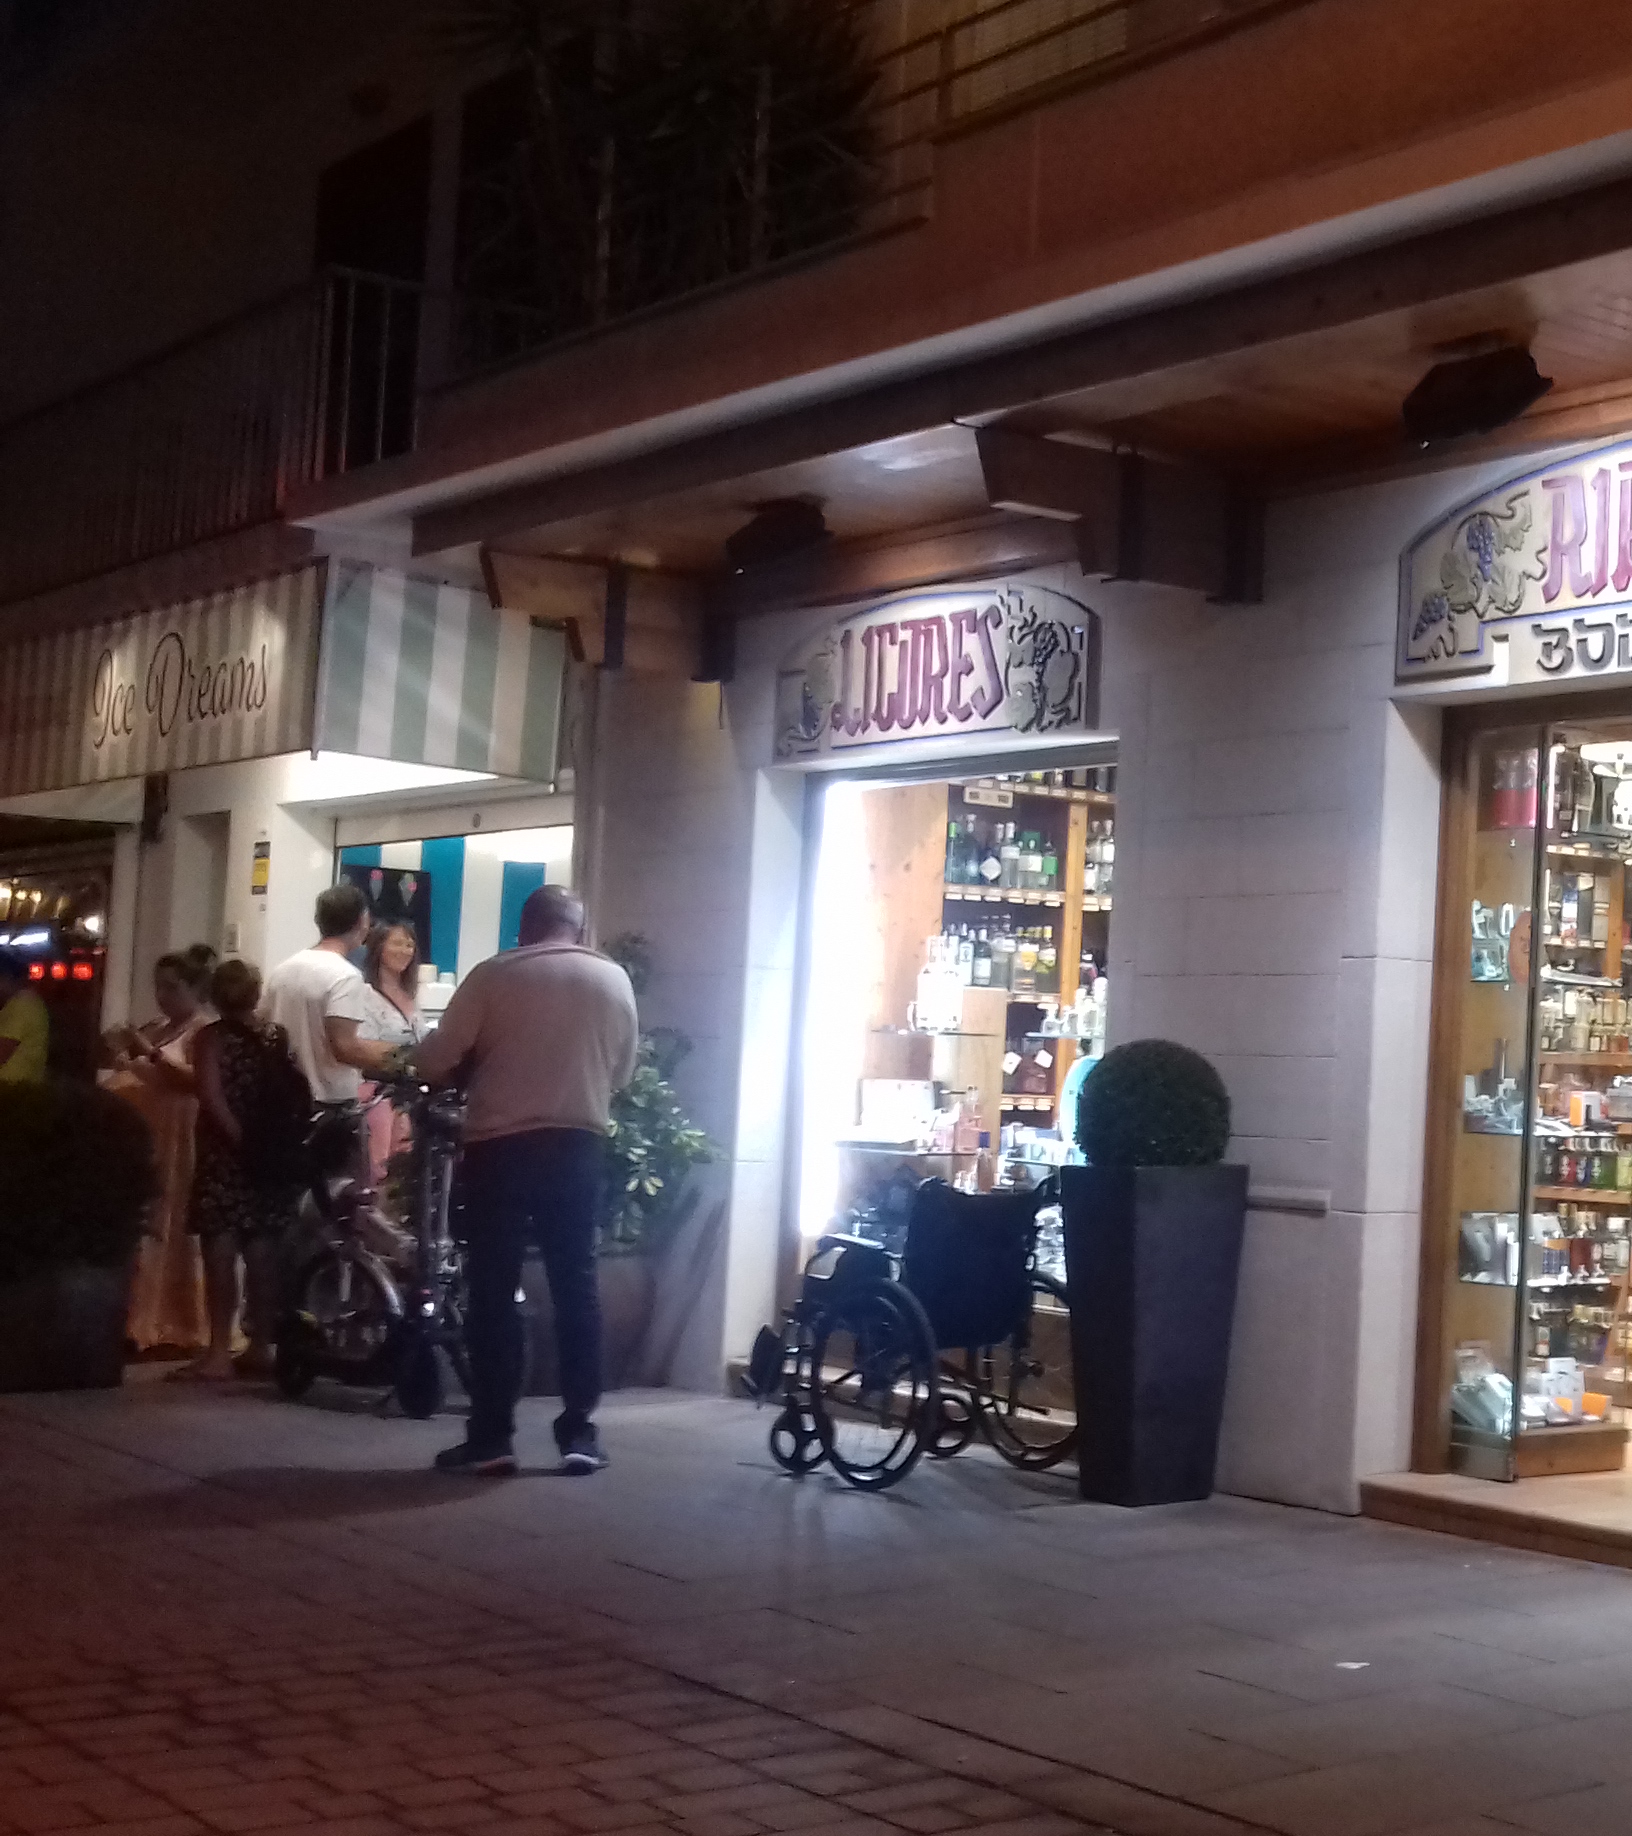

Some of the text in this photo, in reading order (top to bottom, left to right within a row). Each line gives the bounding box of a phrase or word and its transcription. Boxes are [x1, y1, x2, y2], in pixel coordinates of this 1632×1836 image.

[93, 631, 267, 750] Ice Dreams
[830, 603, 1005, 737] LICORES
